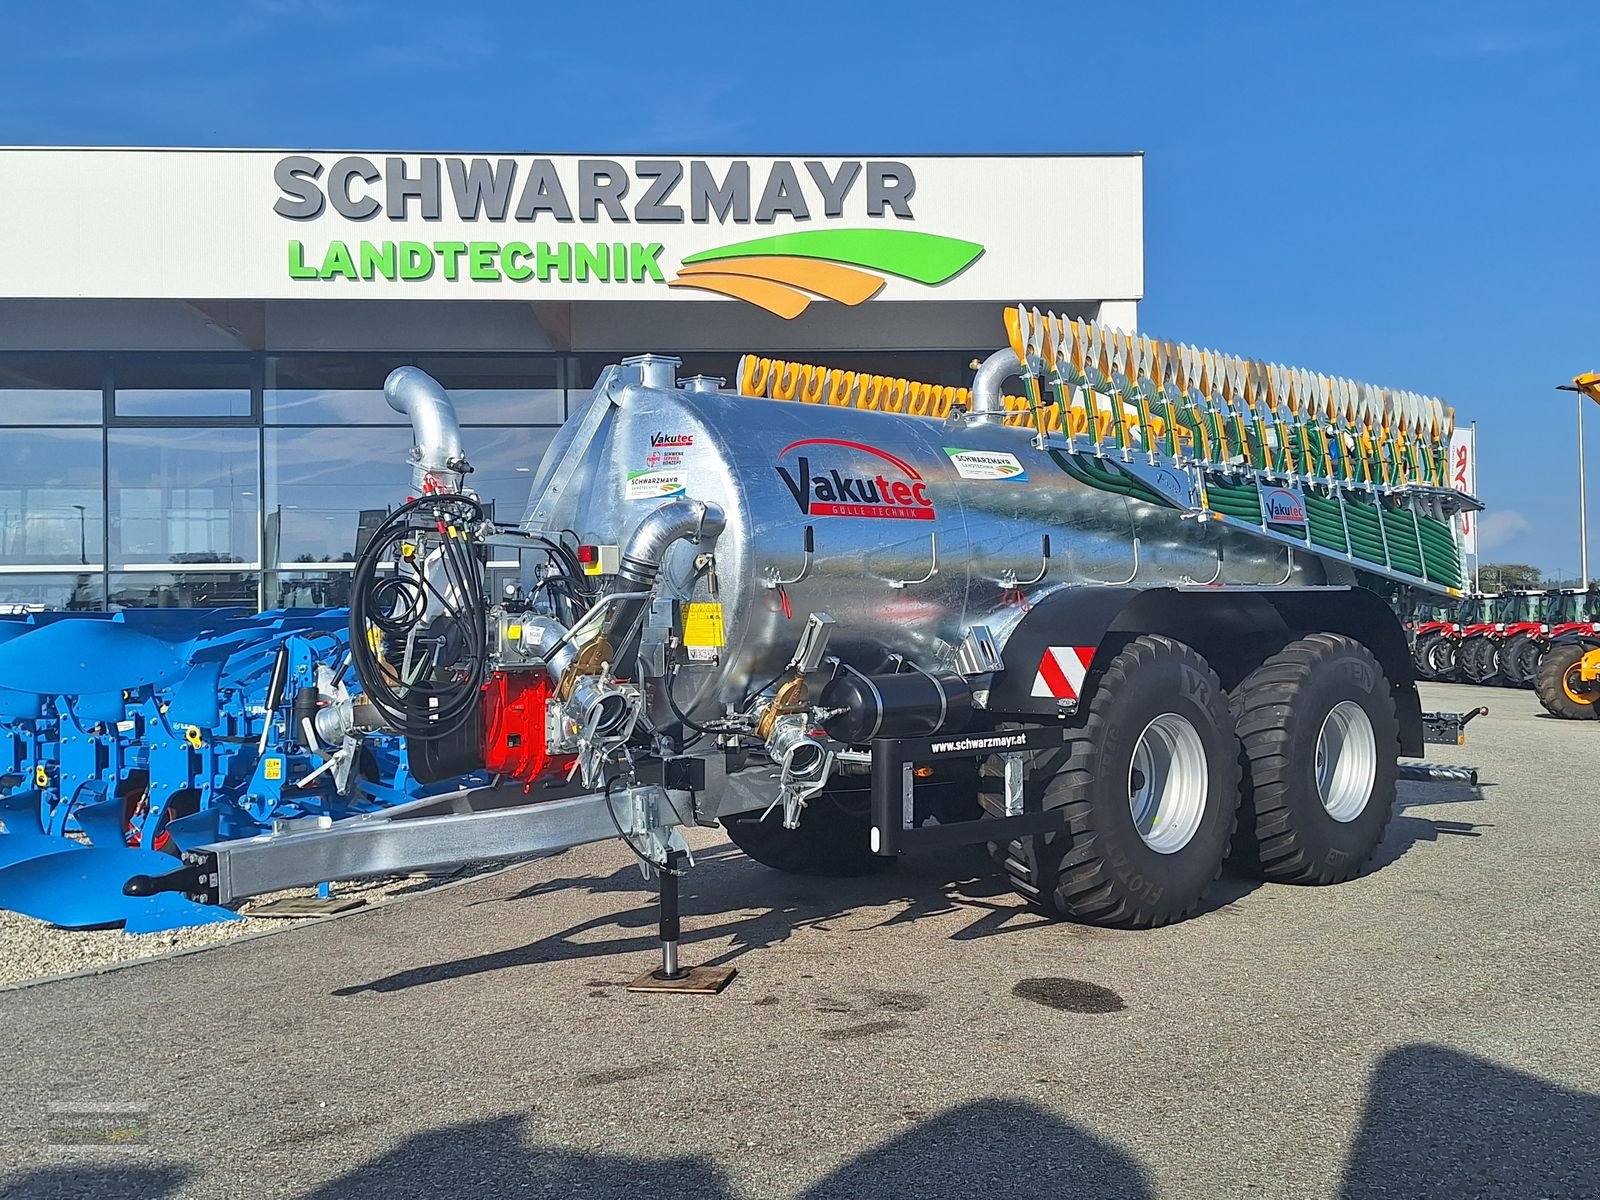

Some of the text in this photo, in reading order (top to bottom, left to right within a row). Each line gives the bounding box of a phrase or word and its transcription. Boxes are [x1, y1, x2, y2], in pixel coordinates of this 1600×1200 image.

[273, 156, 917, 225] SCHWARZMAYR
[287, 239, 667, 283] LANDTECHNIK
[650, 431, 693, 448] Vakutec
[955, 455, 1012, 466] SCHWARZMAYR
[631, 477, 678, 485] SCHWARZMAYR
[774, 456, 933, 515] Vakutec
[873, 507, 917, 518] TECHNIK
[1265, 498, 1304, 520] Vakutec
[931, 732, 1027, 753] www.schwarzmayr.at
